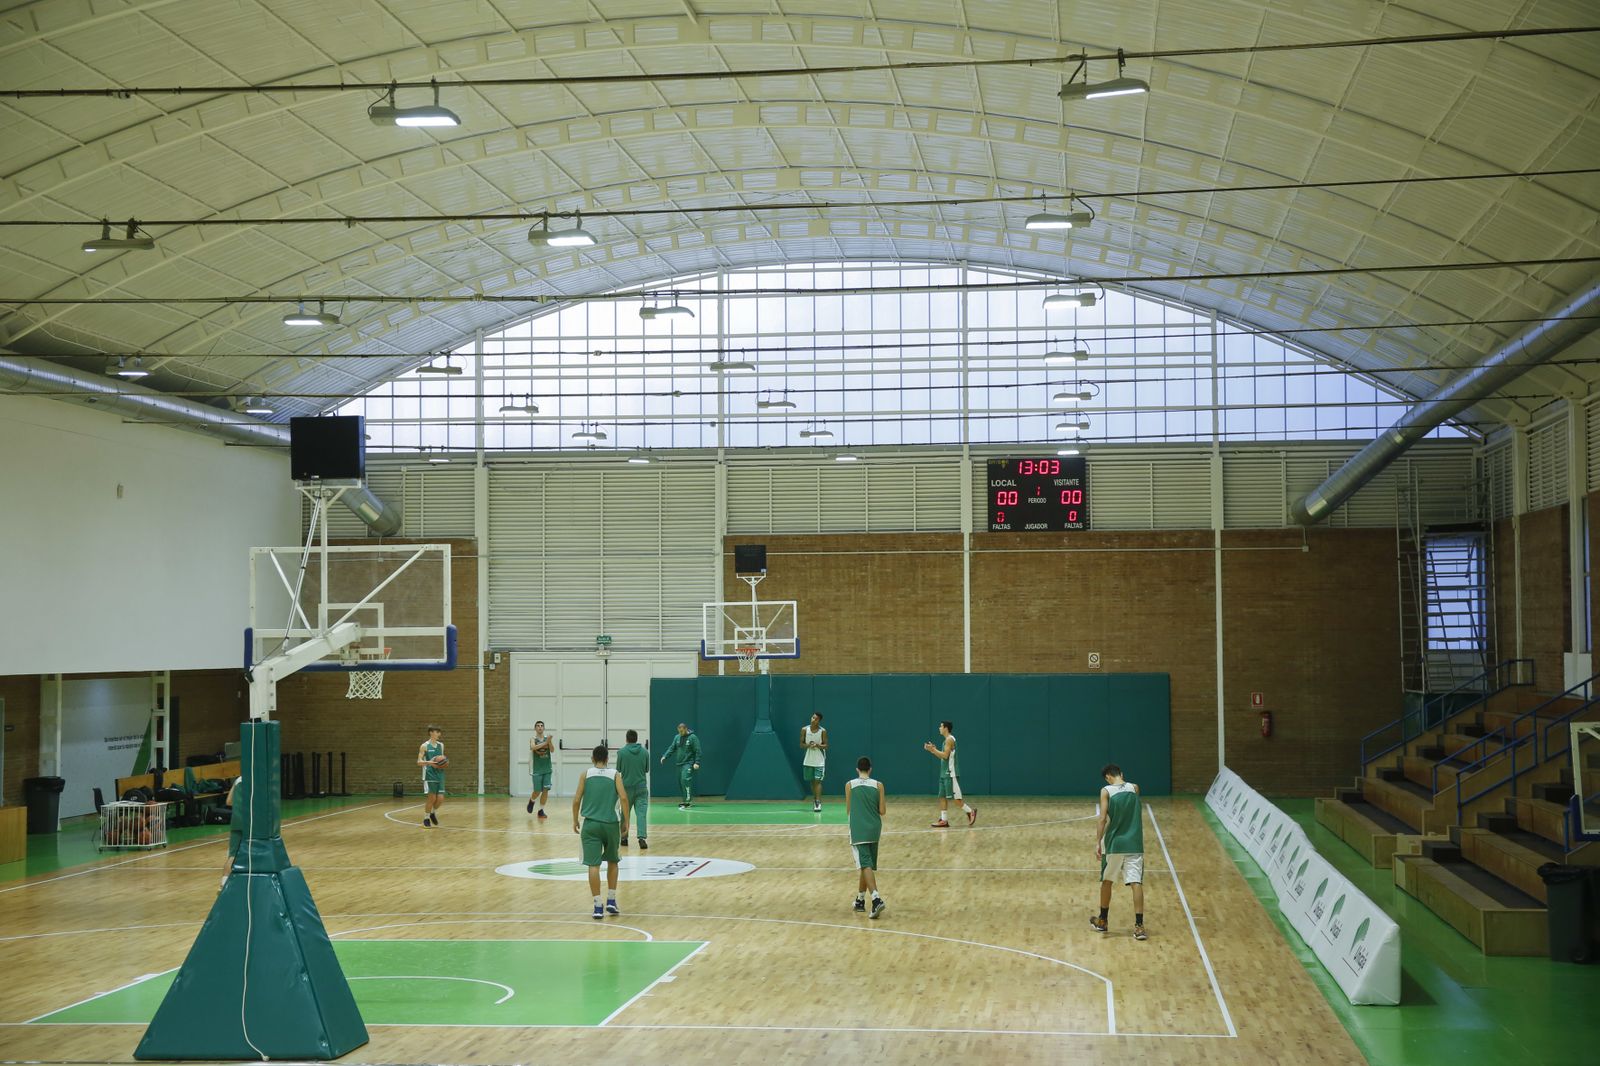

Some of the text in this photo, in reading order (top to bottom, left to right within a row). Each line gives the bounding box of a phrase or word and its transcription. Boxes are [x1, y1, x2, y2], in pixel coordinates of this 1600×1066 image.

[1019, 460, 1060, 475] 13:03
[991, 479, 1017, 487] LOCAL
[1053, 478, 1080, 486] VISITANTE
[997, 491, 1018, 505] 00
[1061, 490, 1082, 505] 00
[1069, 510, 1077, 522] 0
